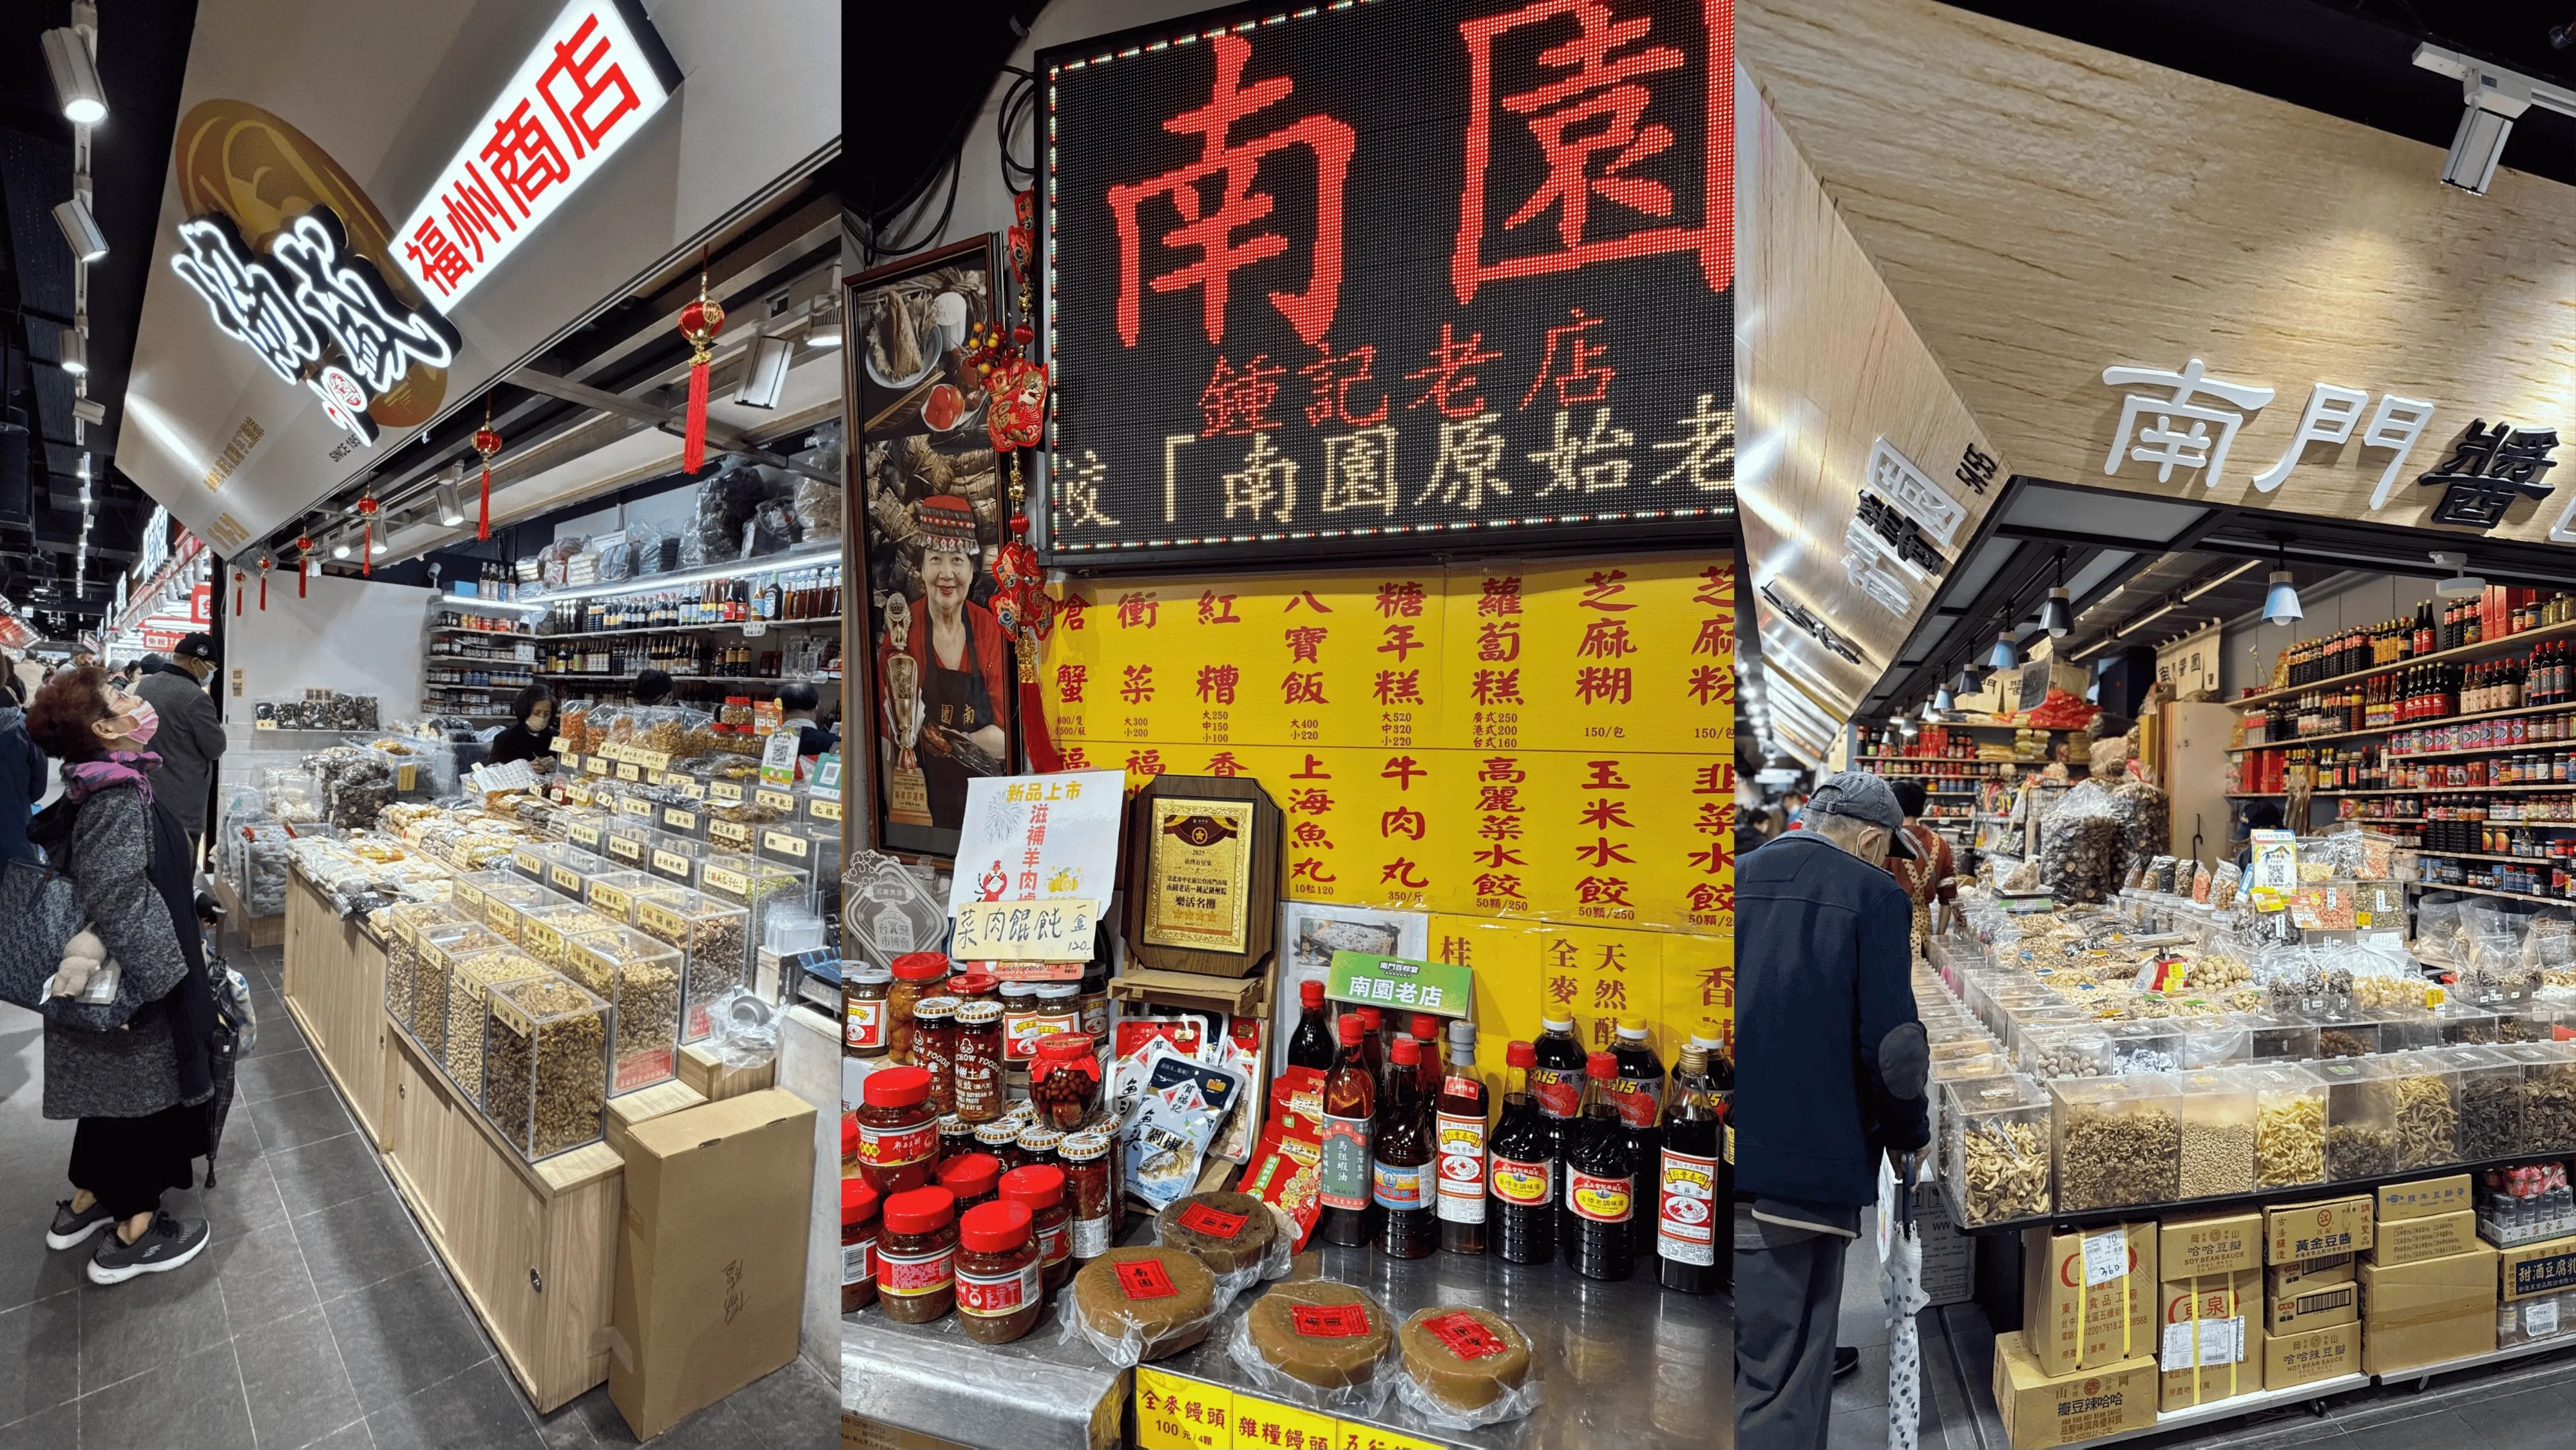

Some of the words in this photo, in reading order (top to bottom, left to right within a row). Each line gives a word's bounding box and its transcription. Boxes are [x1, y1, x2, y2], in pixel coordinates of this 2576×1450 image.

[405, 13, 642, 298] 福州商店
[1107, 0, 1734, 348] 南園
[329, 443, 351, 463] SINCE
[347, 434, 362, 453] 195
[2101, 358, 2576, 543] 南門醬
[1954, 443, 1998, 495] 5455
[1372, 581, 1427, 707] 糖年糕
[1470, 576, 1525, 707] 蘿蔔糕
[1574, 569, 1639, 705] 芝麻糊
[1054, 592, 1092, 704] 嗆蟹
[1118, 591, 1160, 705] 衝菜
[1196, 589, 1241, 706] 紅糟
[1281, 589, 1334, 706] 八寶飯
[1123, 716, 1149, 727] 大300
[1202, 711, 1228, 720] 大250
[1290, 718, 1319, 729] 大400
[1381, 712, 1412, 723] 大520
[1473, 712, 1518, 724] 廣式250
[1123, 728, 1149, 738] 小200
[1202, 721, 1228, 732] 中150
[1381, 724, 1412, 735] 中320
[1473, 725, 1518, 736] 港式200
[1584, 727, 1626, 739] 150/包
[1202, 733, 1228, 743] 小100
[1290, 730, 1319, 741] 小220
[1381, 736, 1412, 747] 小220
[1473, 737, 1518, 749] 台式160
[712, 786, 735, 797] 八仙果
[1006, 780, 1083, 803] 新品上市
[1289, 754, 1336, 883] 上海魚丸
[1380, 755, 1429, 888] 牛肉丸
[712, 824, 738, 838] 無花果乾
[1472, 756, 1529, 899] 高麗菜水餃
[1575, 760, 1637, 908] 玉米水餃
[656, 856, 683, 872] 去核橄欖
[1294, 883, 1334, 896] 10粒120
[1475, 897, 1528, 911] 50顆/250
[1578, 906, 1635, 921] 50顆/250
[1688, 913, 1734, 927] 50顆/2
[957, 908, 1063, 949] 菜肉餛飩
[1379, 962, 1420, 974] 南門百粽宴
[1349, 976, 1443, 1008] 南園老店
[926, 1050, 951, 1068] FOODS
[978, 1056, 1000, 1073] FOODS
[1337, 1140, 1349, 1183] 馬祖蝦油
[2276, 1217, 2287, 1260] 古法釀造
[2295, 1232, 2352, 1253] 黃金豆醬
[2188, 1240, 2242, 1257] 哈哈豆瓣
[2200, 1255, 2220, 1264] BEAN
[2221, 1252, 2244, 1260] SAUCE
[2519, 1257, 2576, 1283] 甜酒豆腐乳
[2283, 1344, 2347, 1364] 哈哈辣豆瓣
[2302, 1360, 2320, 1369] BEAN
[2321, 1355, 2343, 1365] SAUCE
[1141, 1389, 1226, 1429] 全麥饅頭
[2094, 1411, 2106, 1419] BEAN
[2107, 1407, 2122, 1416] SAUCE
[1156, 1419, 1179, 1436] 100
